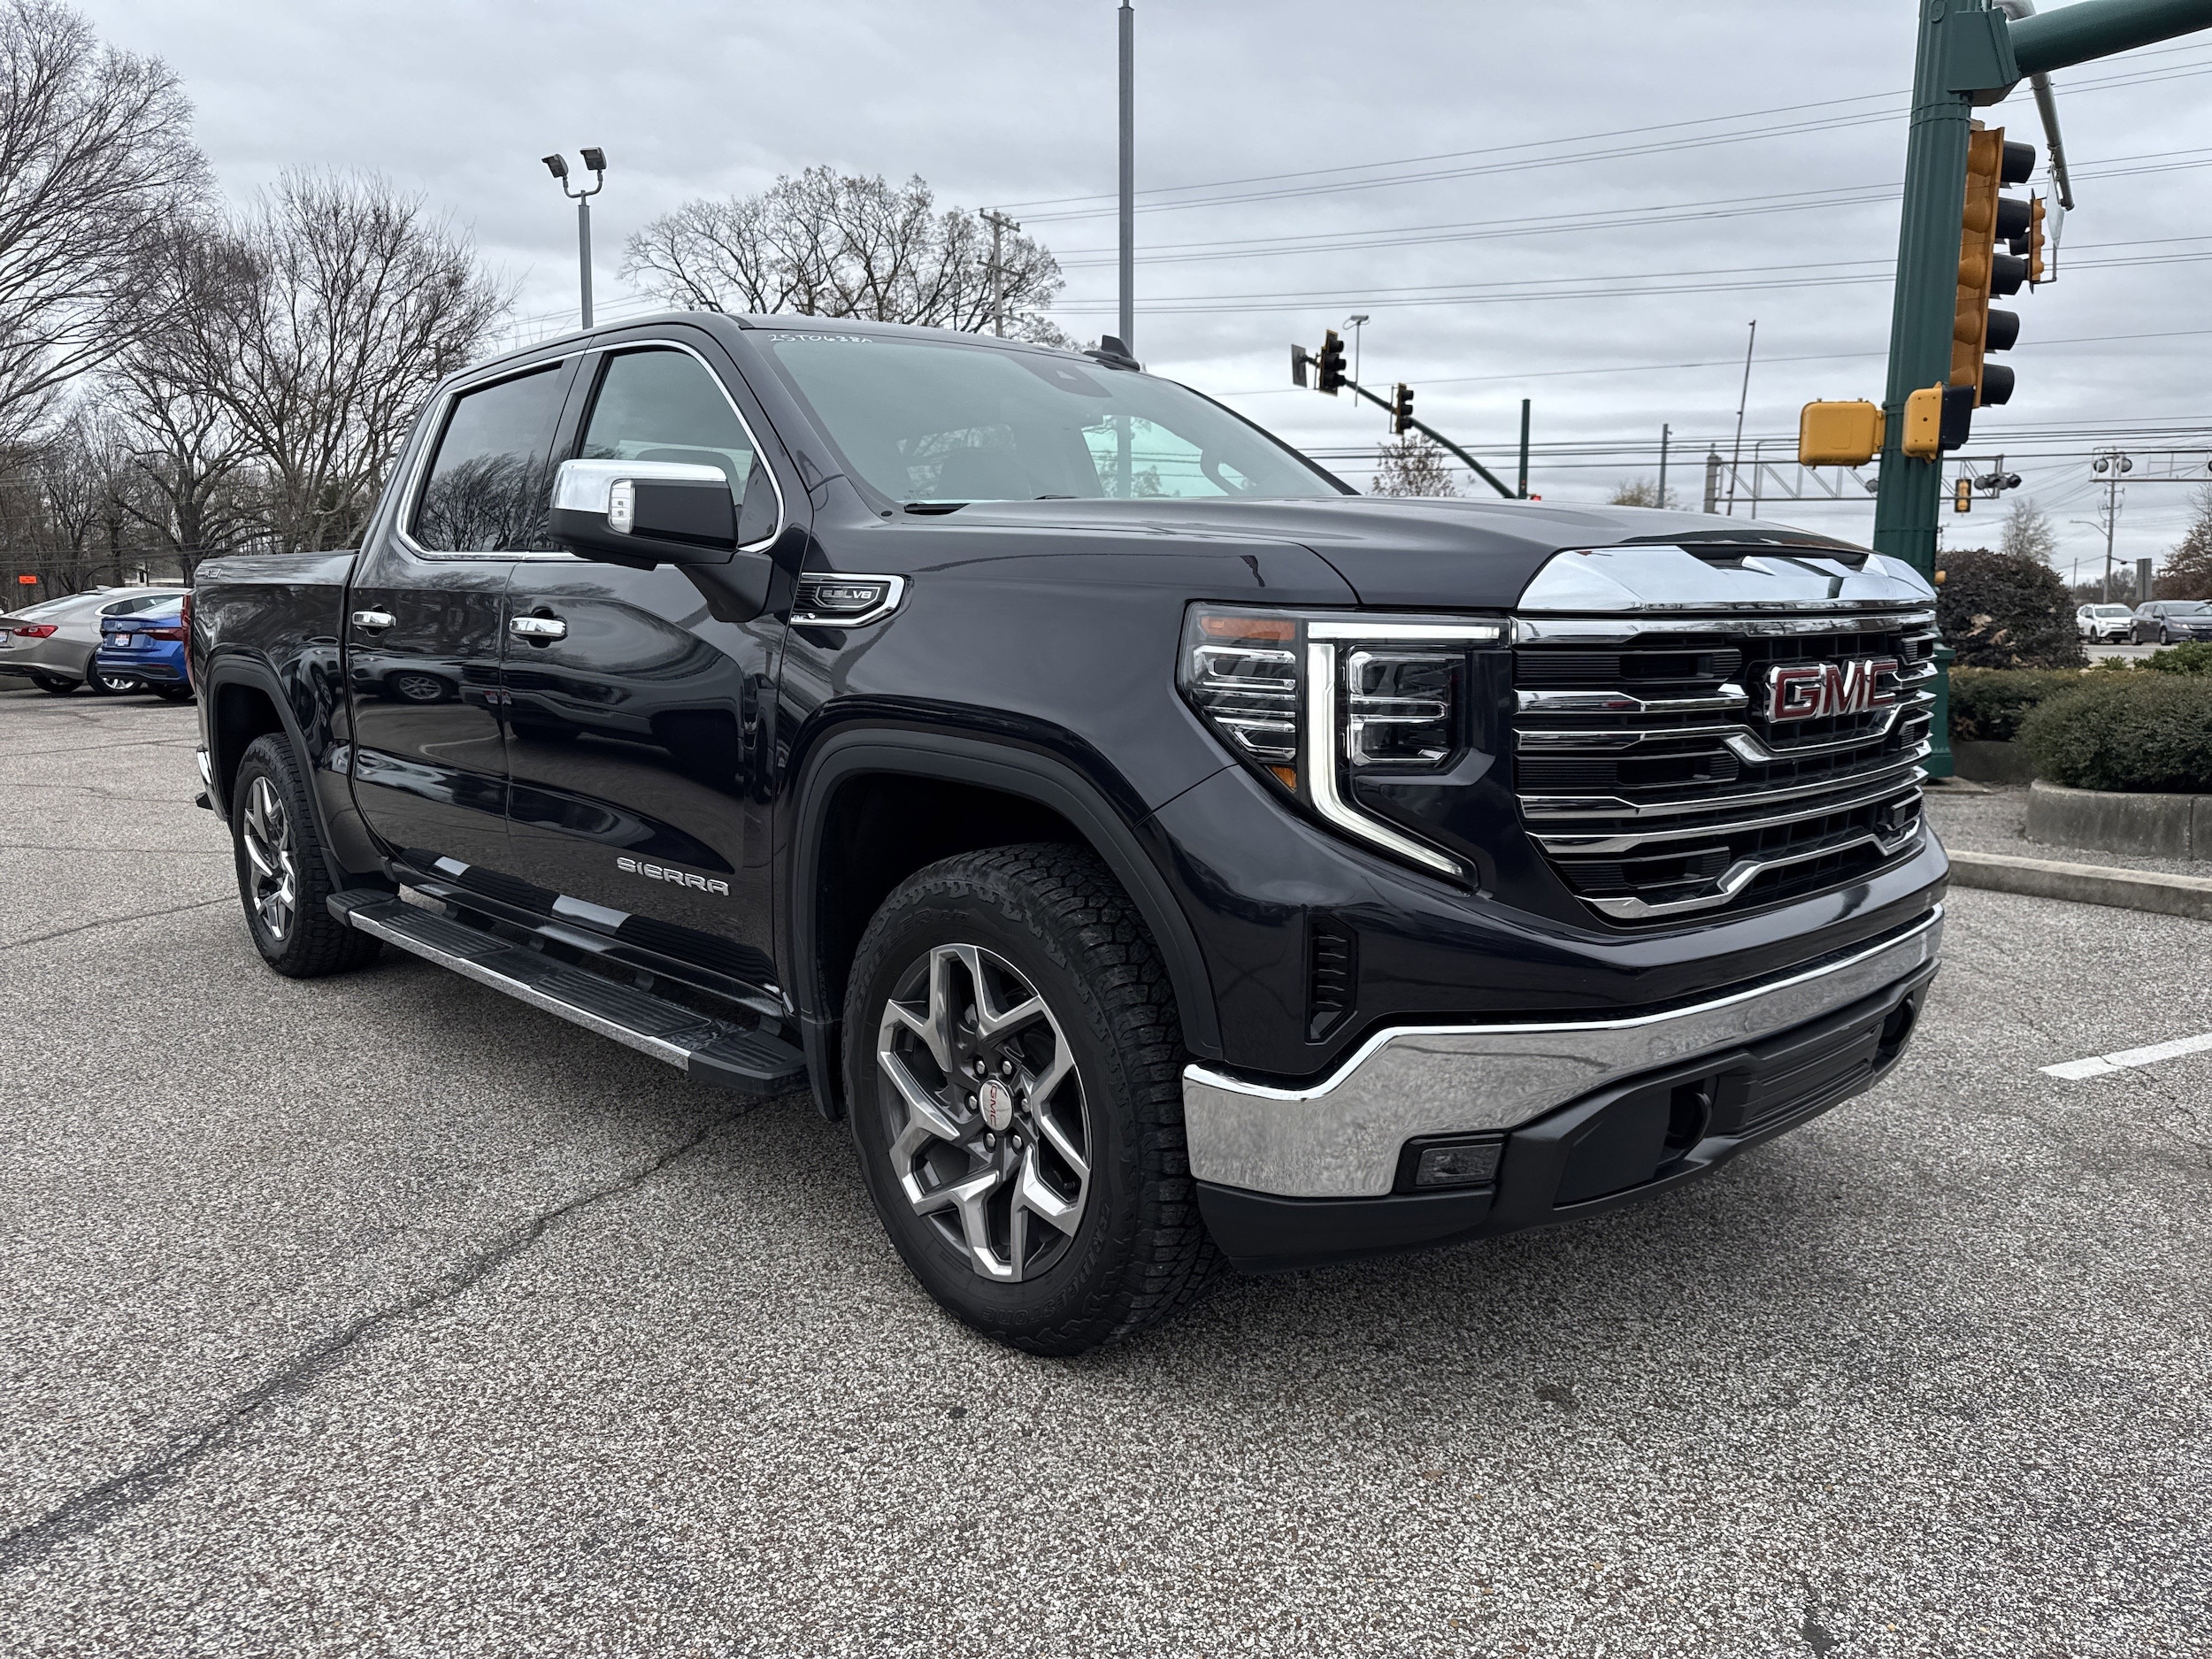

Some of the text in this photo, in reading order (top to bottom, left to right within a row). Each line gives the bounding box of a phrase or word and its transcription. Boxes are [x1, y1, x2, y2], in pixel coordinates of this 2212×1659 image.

[1769, 659, 1899, 724] GMC
[616, 856, 730, 896] SIERRA
[989, 1083, 998, 1127] GMC
[981, 1201, 1112, 1326] BRIDGESTONE
